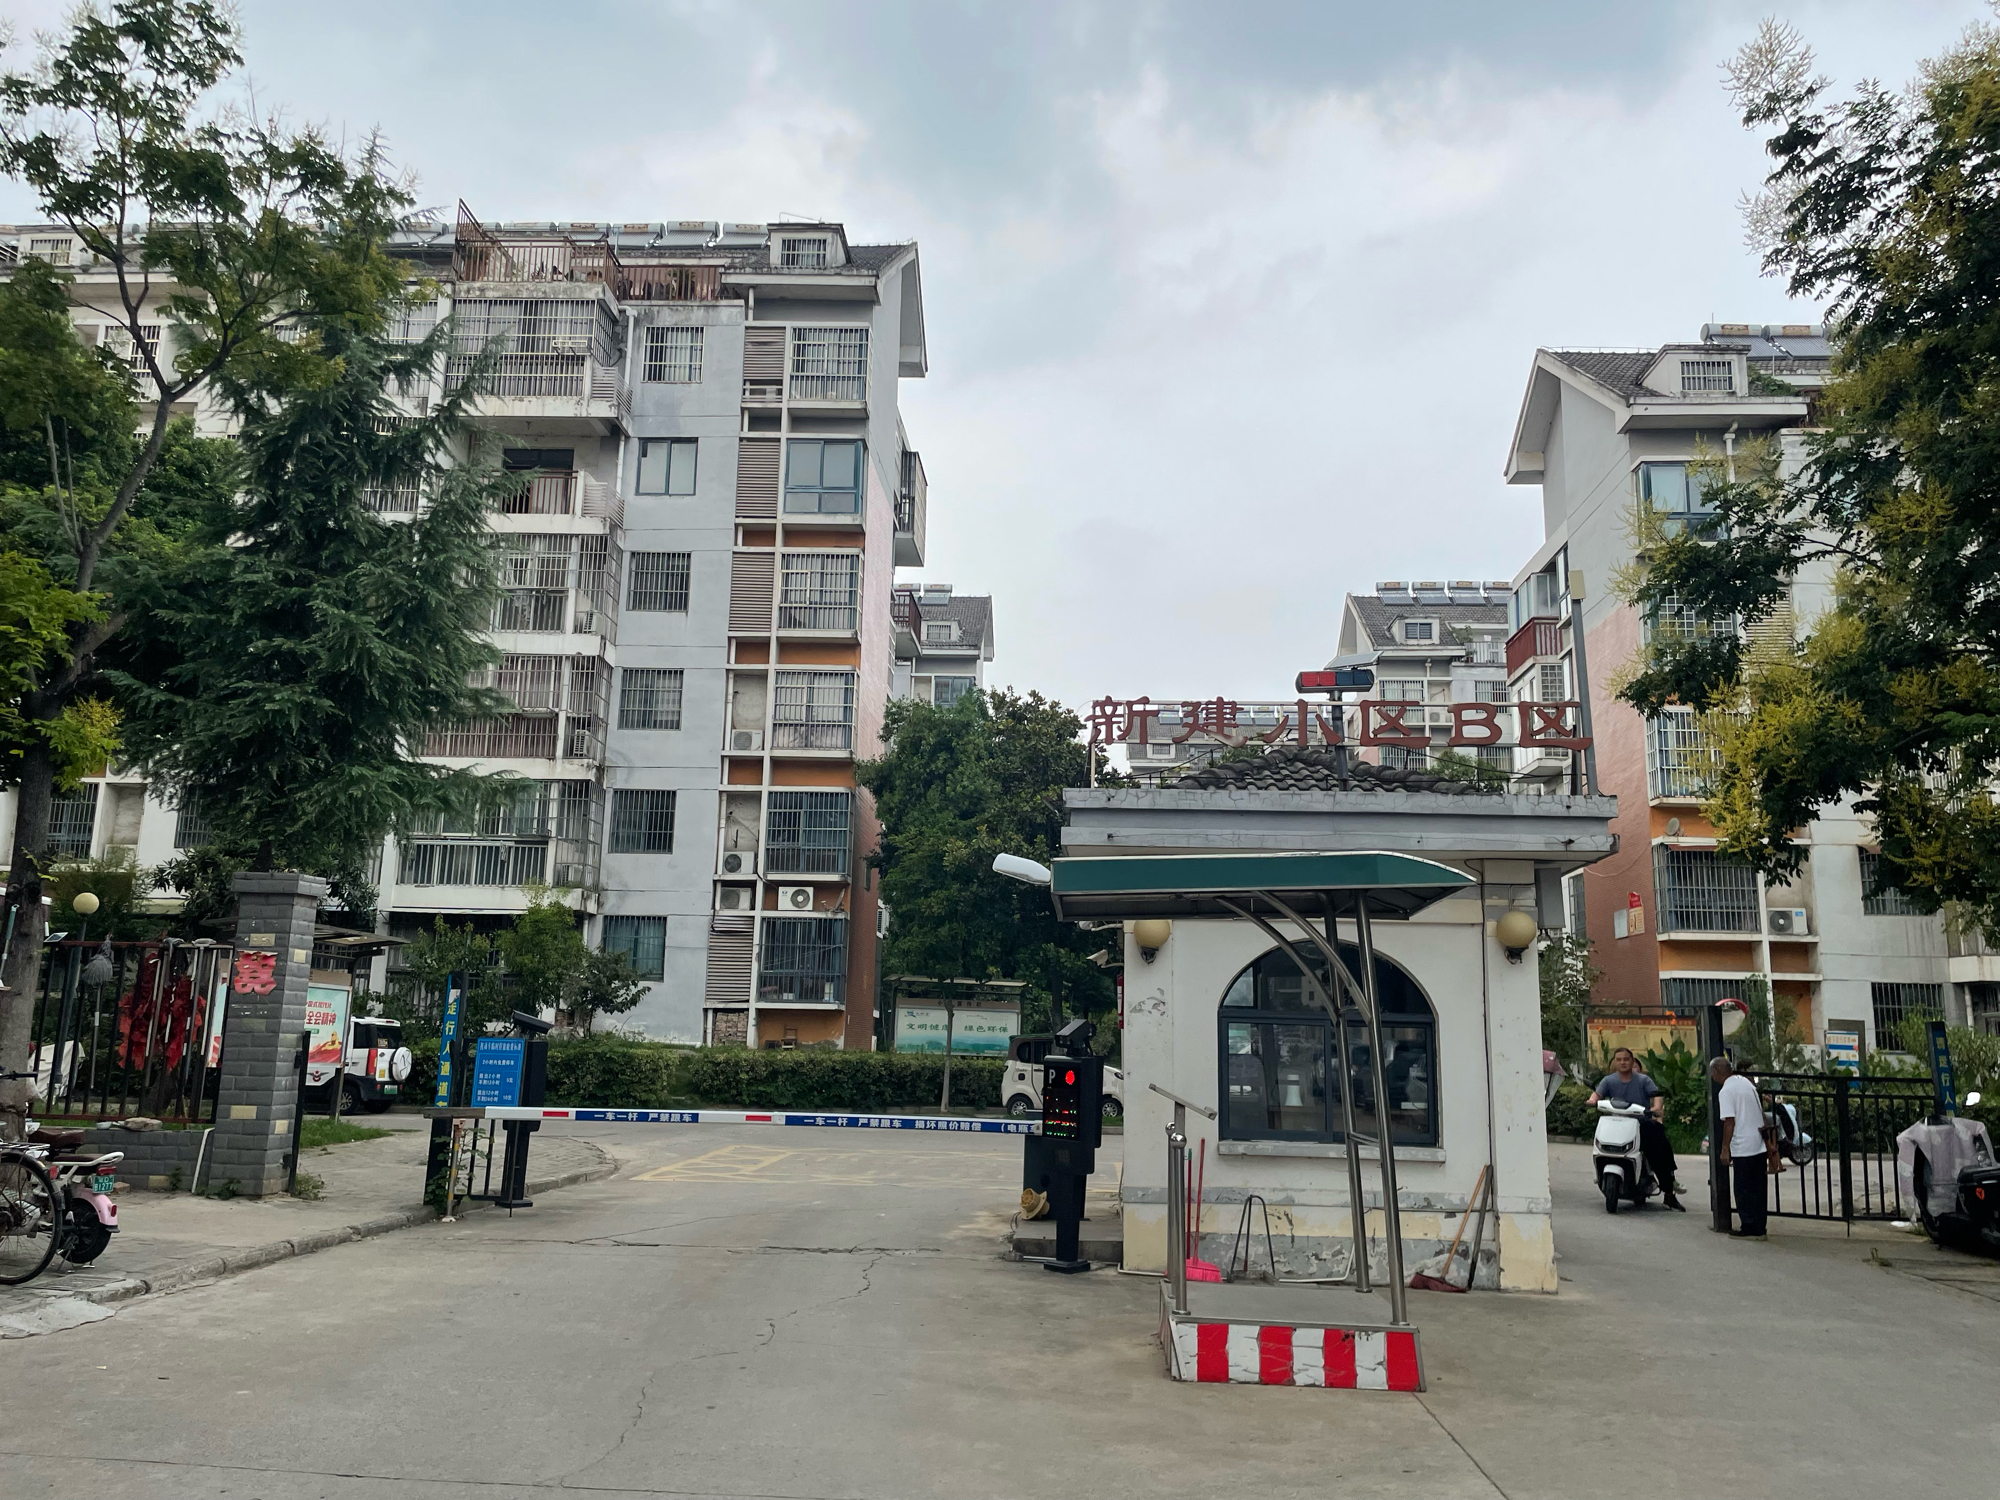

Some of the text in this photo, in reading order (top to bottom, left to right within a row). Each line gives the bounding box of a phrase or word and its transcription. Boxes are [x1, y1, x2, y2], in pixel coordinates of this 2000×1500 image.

[1084, 695, 1592, 749] 新建小区B区
[937, 1000, 982, 1008] 小宣传栏
[305, 1011, 337, 1026] 全会精神
[964, 1024, 1009, 1034] 绿色环保
[1048, 1069, 1056, 1084] P
[594, 1112, 693, 1123] 一车一杆 严禁跟车
[803, 1116, 849, 1127] 一车一杆
[857, 1118, 903, 1129] 严禁跟车
[914, 1120, 982, 1132] 损坏照价赔偿
